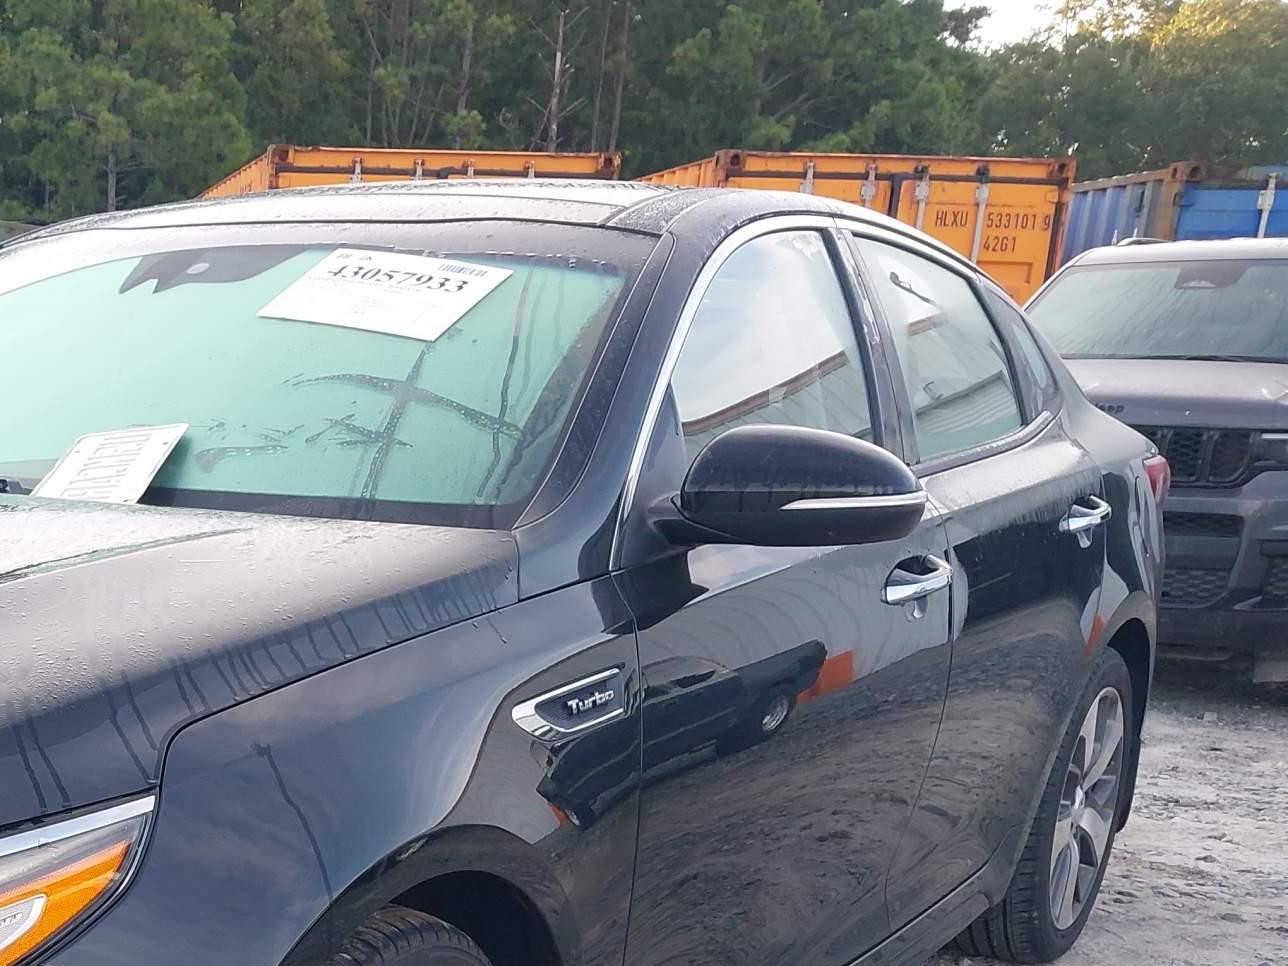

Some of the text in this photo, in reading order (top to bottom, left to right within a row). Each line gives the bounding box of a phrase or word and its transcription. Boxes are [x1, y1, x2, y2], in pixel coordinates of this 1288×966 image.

[935, 209, 1051, 231] HLXU 533101 9
[983, 235, 1017, 253] 42G1
[327, 264, 469, 293] 43057933
[566, 689, 615, 715] Turbo
